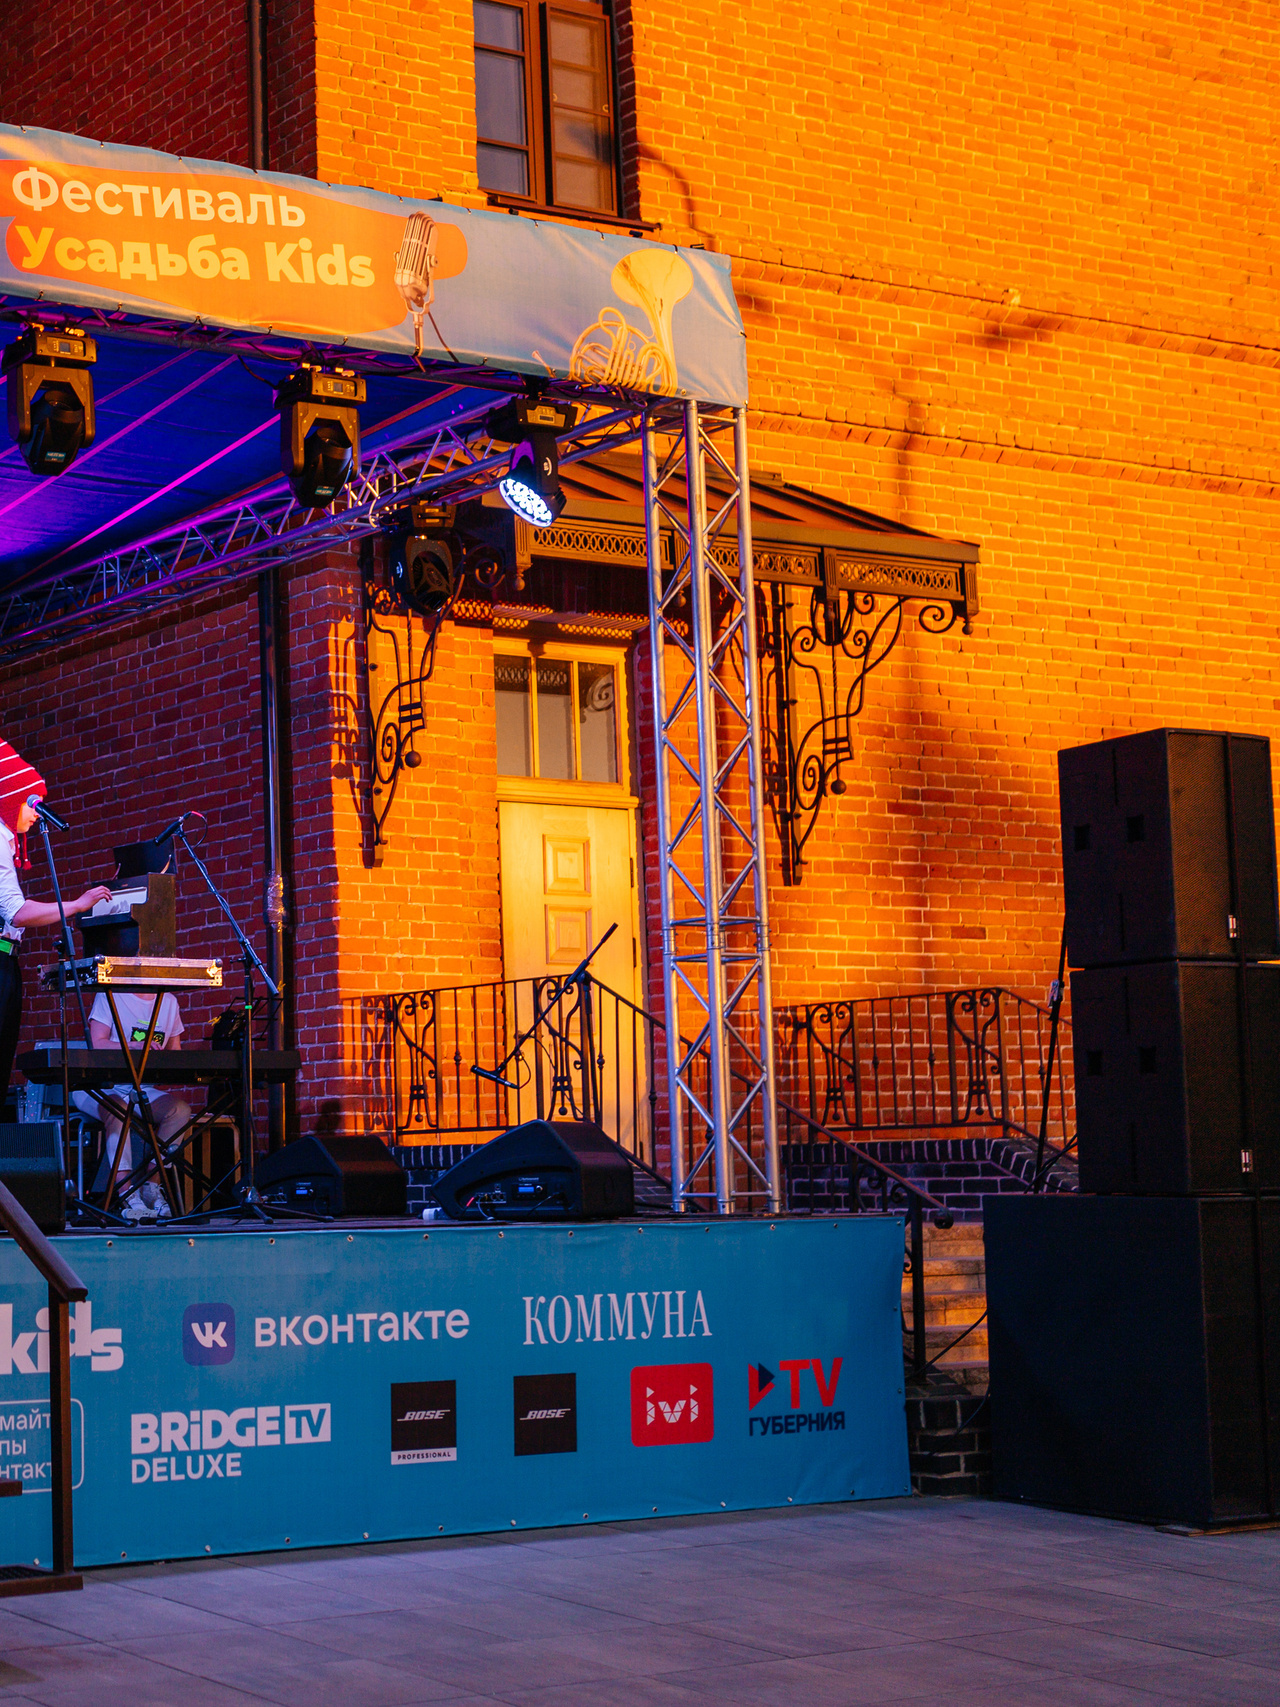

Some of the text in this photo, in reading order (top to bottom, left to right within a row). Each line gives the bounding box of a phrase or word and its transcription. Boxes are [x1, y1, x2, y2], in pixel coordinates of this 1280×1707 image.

[12, 166, 306, 228] Фестиваль
[16, 225, 376, 287] Усадьба Kids
[522, 1290, 713, 1345] КОММУНА
[778, 1356, 844, 1409] TV
[397, 1409, 451, 1422] BOSE
[519, 1408, 571, 1421] BOSE
[646, 1384, 699, 1425] ivi
[288, 1407, 327, 1440] TV
[748, 1411, 846, 1437] ГУБЕРНИЯ
[131, 1452, 242, 1484] DELUXE
[397, 1451, 451, 1461] PROFESSIONAL
